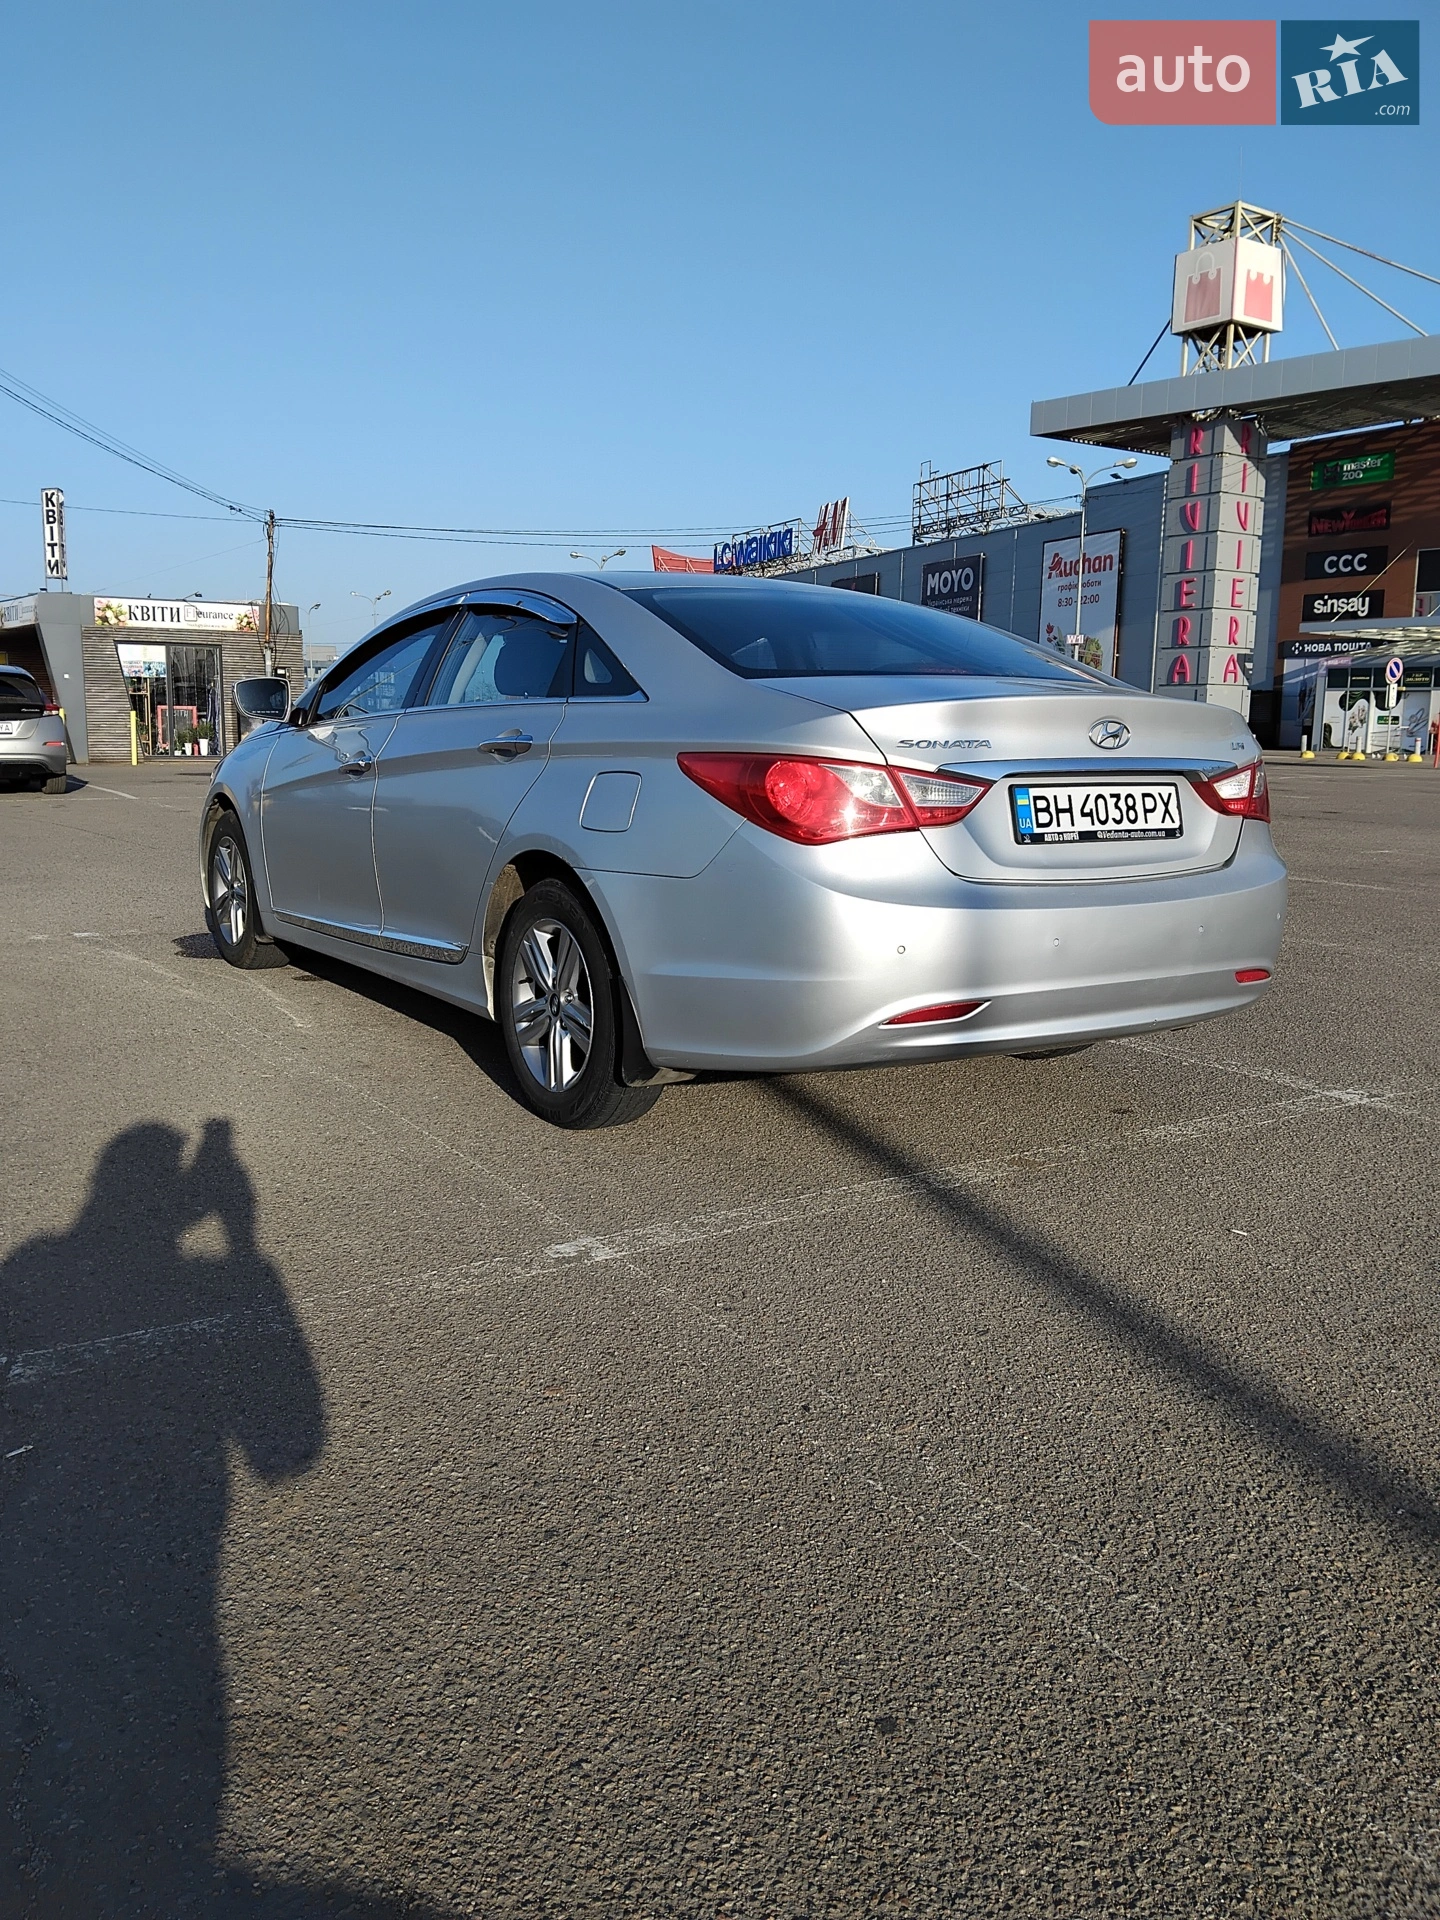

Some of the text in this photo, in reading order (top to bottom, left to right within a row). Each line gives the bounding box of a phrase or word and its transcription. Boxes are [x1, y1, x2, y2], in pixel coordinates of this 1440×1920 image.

[1343, 457, 1383, 471] master
[1342, 470, 1363, 480] zoo
[45, 492, 59, 574] КВІТИ
[1173, 426, 1204, 683] RIVIERA
[1223, 423, 1252, 683] RIVIERA
[1048, 552, 1114, 579] Auchan
[1324, 553, 1368, 573] CCC
[927, 567, 974, 596] MOYO
[1080, 579, 1102, 589] оботи
[1058, 596, 1073, 607] 8:30
[1313, 595, 1370, 617] sinsay
[128, 605, 181, 622] КВІТИ
[1304, 641, 1371, 652] НОВА ПОШТА
[896, 739, 992, 749] SONATA
[1033, 792, 1175, 828] BH 4038 PX
[1019, 818, 1032, 828] UA
